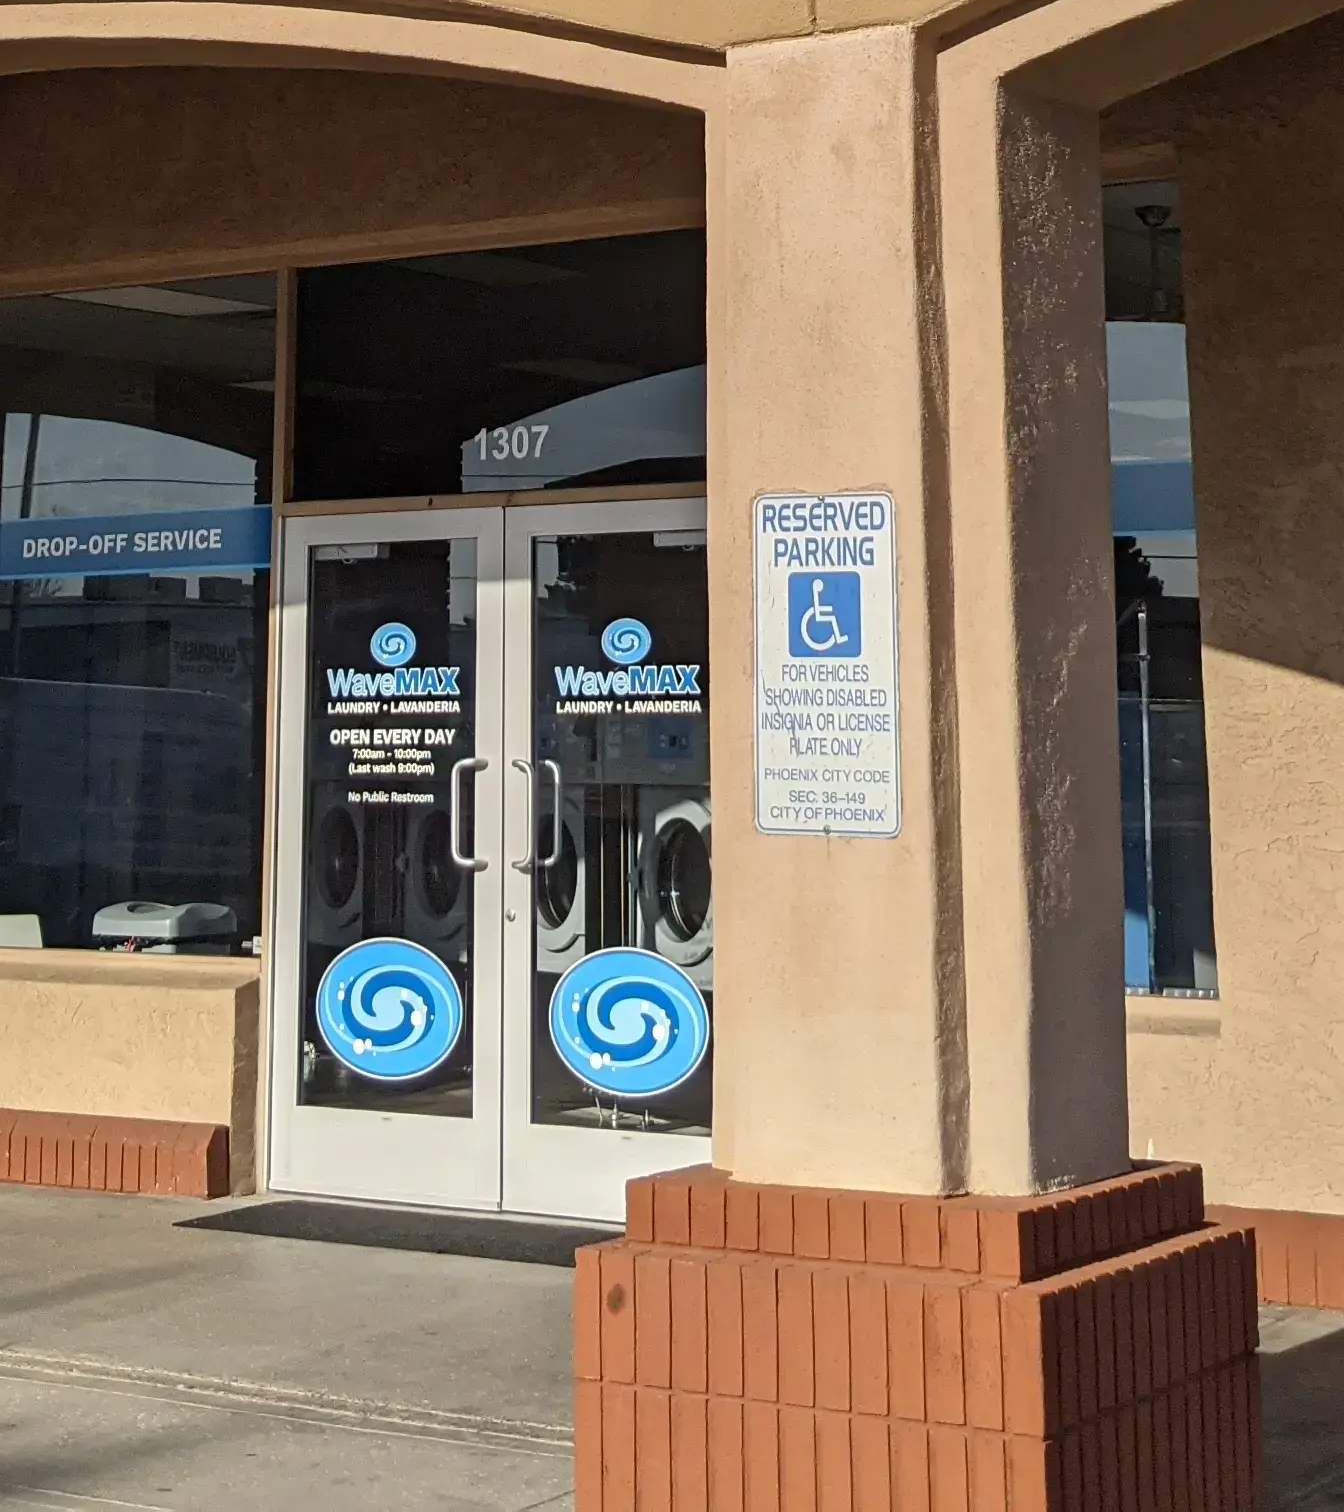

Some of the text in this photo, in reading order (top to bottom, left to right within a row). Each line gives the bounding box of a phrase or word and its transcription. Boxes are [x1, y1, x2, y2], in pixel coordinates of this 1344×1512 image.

[474, 424, 549, 460] 1307
[762, 501, 885, 533] RESERVED
[22, 528, 222, 558] DROP-OFF SERVICE
[774, 536, 874, 567] PARKING
[326, 667, 461, 697] WaveMAX
[554, 665, 701, 696] WaveMAX
[781, 664, 869, 682] FOR VEHICLES
[764, 688, 887, 707] SHOWING DISABLED
[327, 700, 461, 715] LAUNDRY LAVANDERIA
[556, 700, 702, 714] LAUNDRY LAVANDERIA
[761, 712, 891, 732] INSIGNIA OR LICENSE
[329, 728, 456, 745] OPEN EVERY DAY
[352, 748, 385, 760] 7:00am
[393, 748, 431, 761] 10:00pm
[789, 737, 862, 757] PLATE ONLY
[348, 763, 371, 775] (Last
[372, 763, 396, 774] wash
[764, 767, 891, 784] PHOENIX CITY CODE
[348, 791, 434, 803] No Public Restroom
[788, 789, 866, 805] SEC. 36-149
[770, 805, 885, 822] CITY OF PHOENIX
